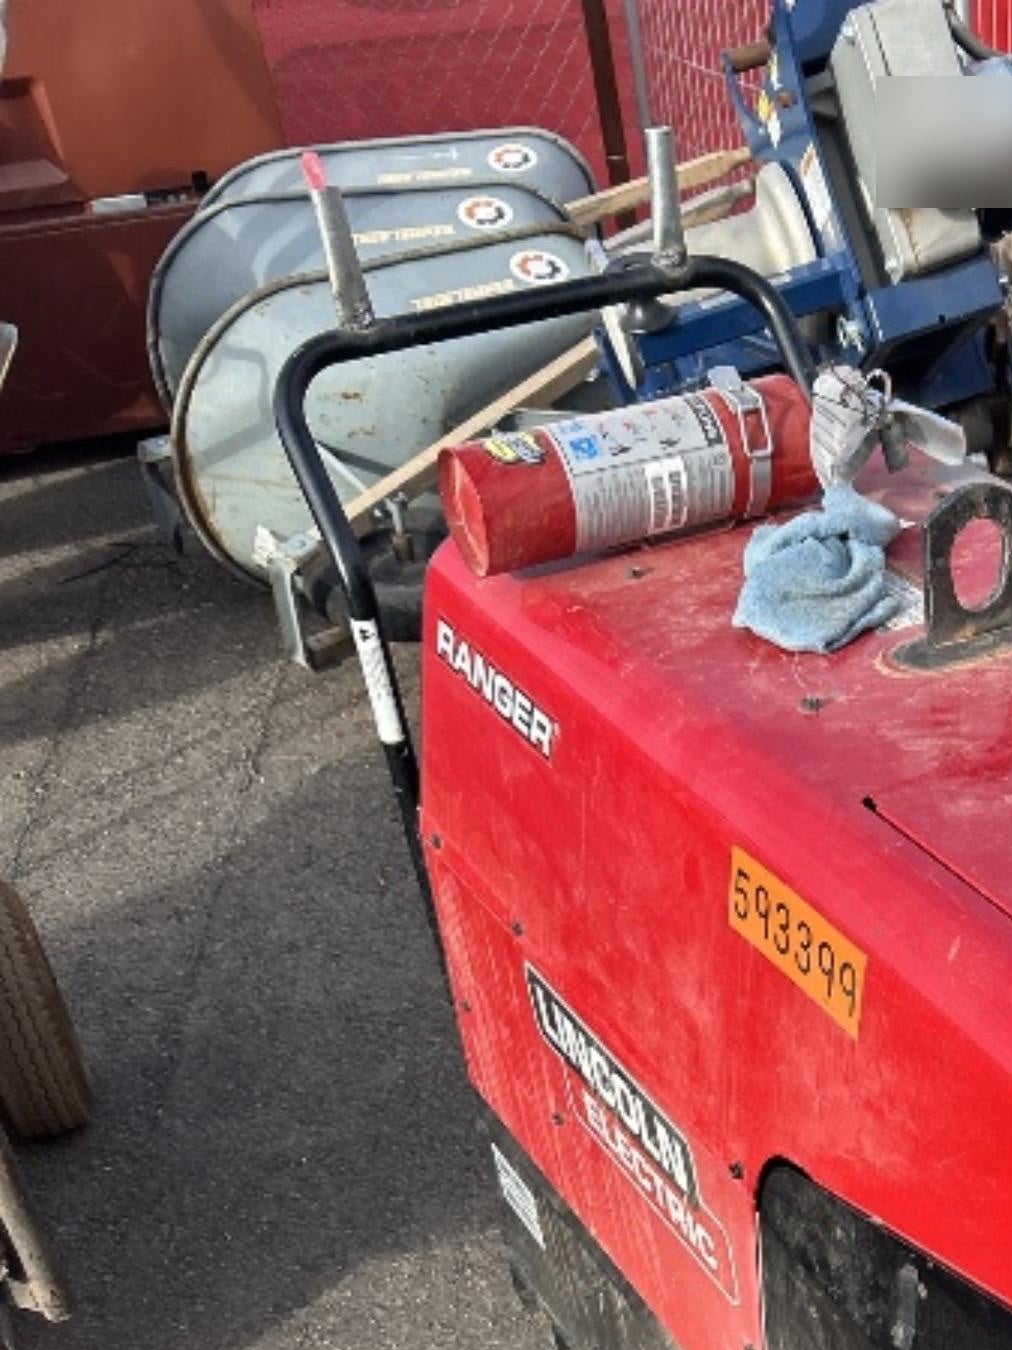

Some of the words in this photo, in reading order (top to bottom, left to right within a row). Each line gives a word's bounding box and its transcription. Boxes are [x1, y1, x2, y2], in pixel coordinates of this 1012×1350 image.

[437, 619, 553, 757] RANGER
[734, 866, 857, 1018] 593399
[534, 982, 690, 1196] LINCOLN
[581, 1086, 718, 1271] ELECTRIC
